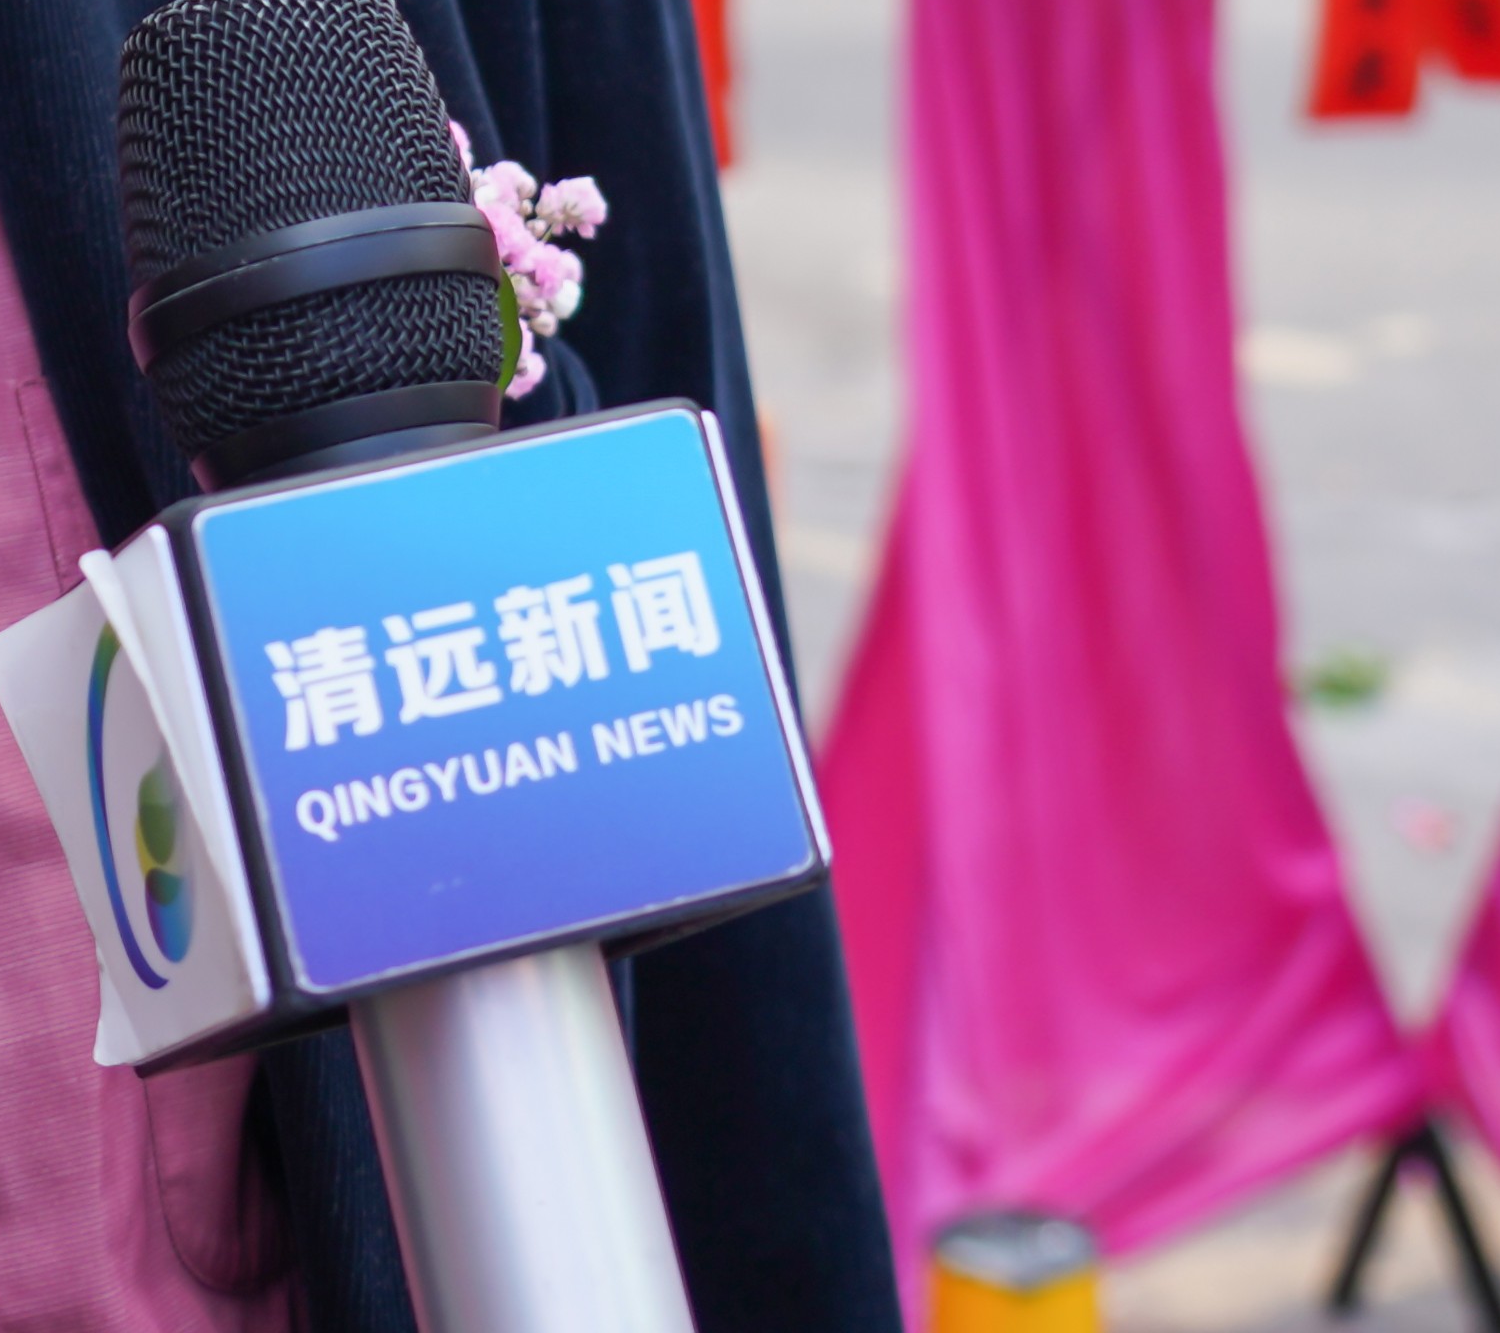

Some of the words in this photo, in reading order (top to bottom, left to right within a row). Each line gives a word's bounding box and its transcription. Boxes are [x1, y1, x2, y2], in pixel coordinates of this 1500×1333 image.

[264, 550, 722, 751] 清远新闻
[295, 733, 577, 842] QINGYUAN
[590, 694, 744, 766] NEWS
